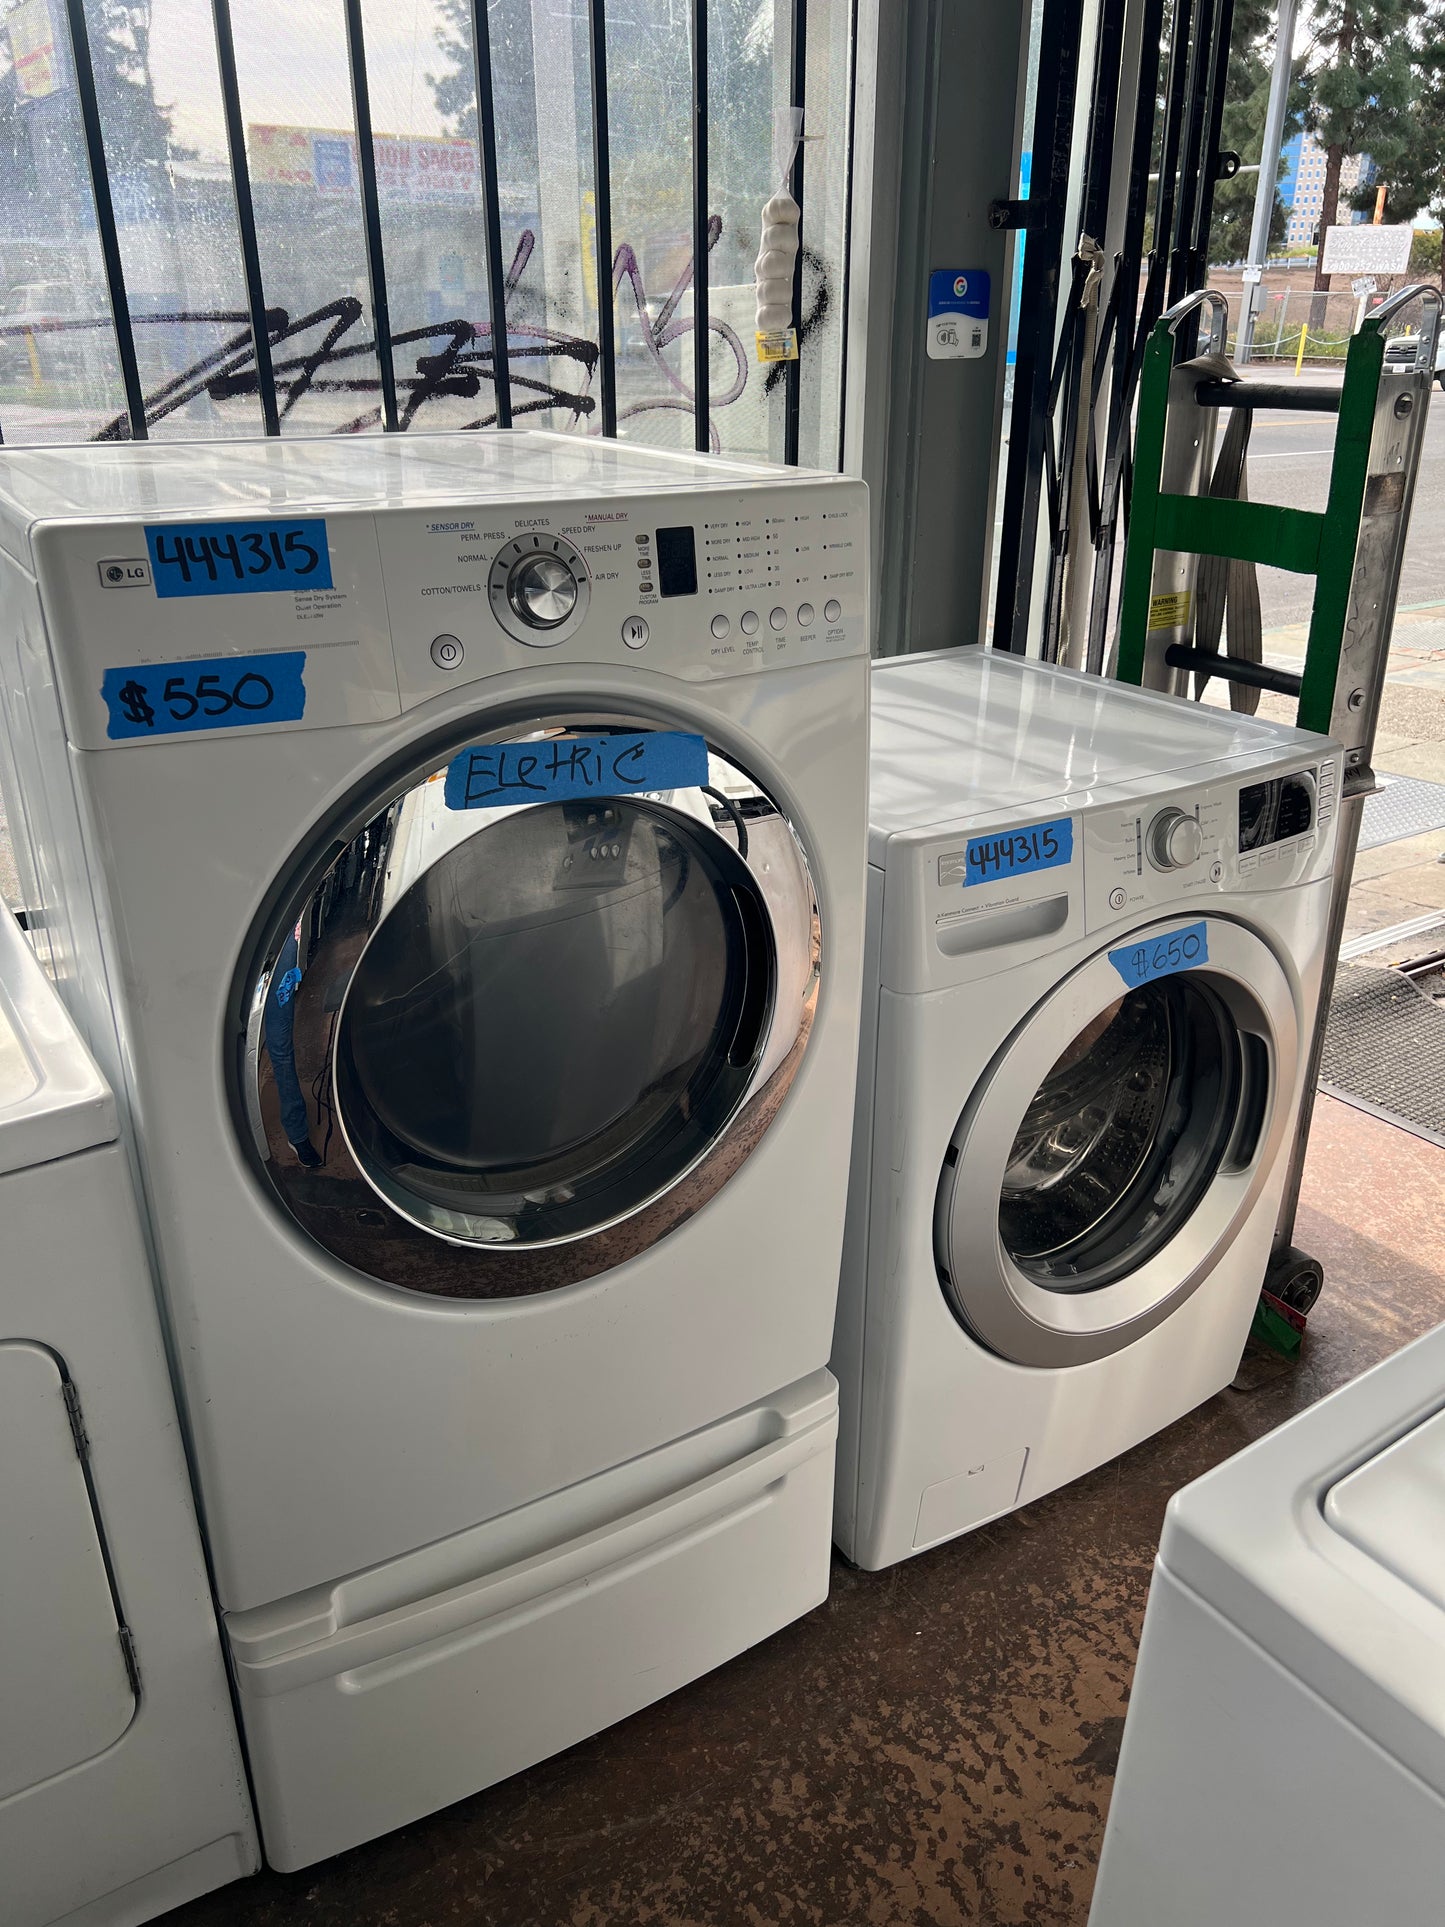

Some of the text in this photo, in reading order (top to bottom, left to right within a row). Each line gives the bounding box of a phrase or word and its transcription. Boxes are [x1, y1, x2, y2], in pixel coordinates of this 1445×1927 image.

[587, 512, 629, 522] MANUAL DRY
[431, 521, 475, 531] SENSOR DRY
[514, 518, 551, 528] DELICATES
[561, 525, 596, 535] SPEED DRY
[483, 532, 506, 540] PRESS
[583, 543, 622, 553] FRESHEN UP
[155, 530, 320, 583] 444315
[457, 554, 489, 563] NORMAL
[127, 567, 145, 579] LG
[595, 572, 619, 581] AIR DRY
[421, 583, 481, 596] COTTON/TOWELS
[1152, 596, 1178, 607] WARNING
[827, 628, 844, 636] OPTION
[800, 634, 816, 642] BEEPER
[721, 646, 736, 654] LEVEL
[742, 646, 765, 655] CONTROL
[118, 672, 275, 728] $550
[969, 827, 1059, 876] 444315
[1130, 933, 1201, 978] $650
